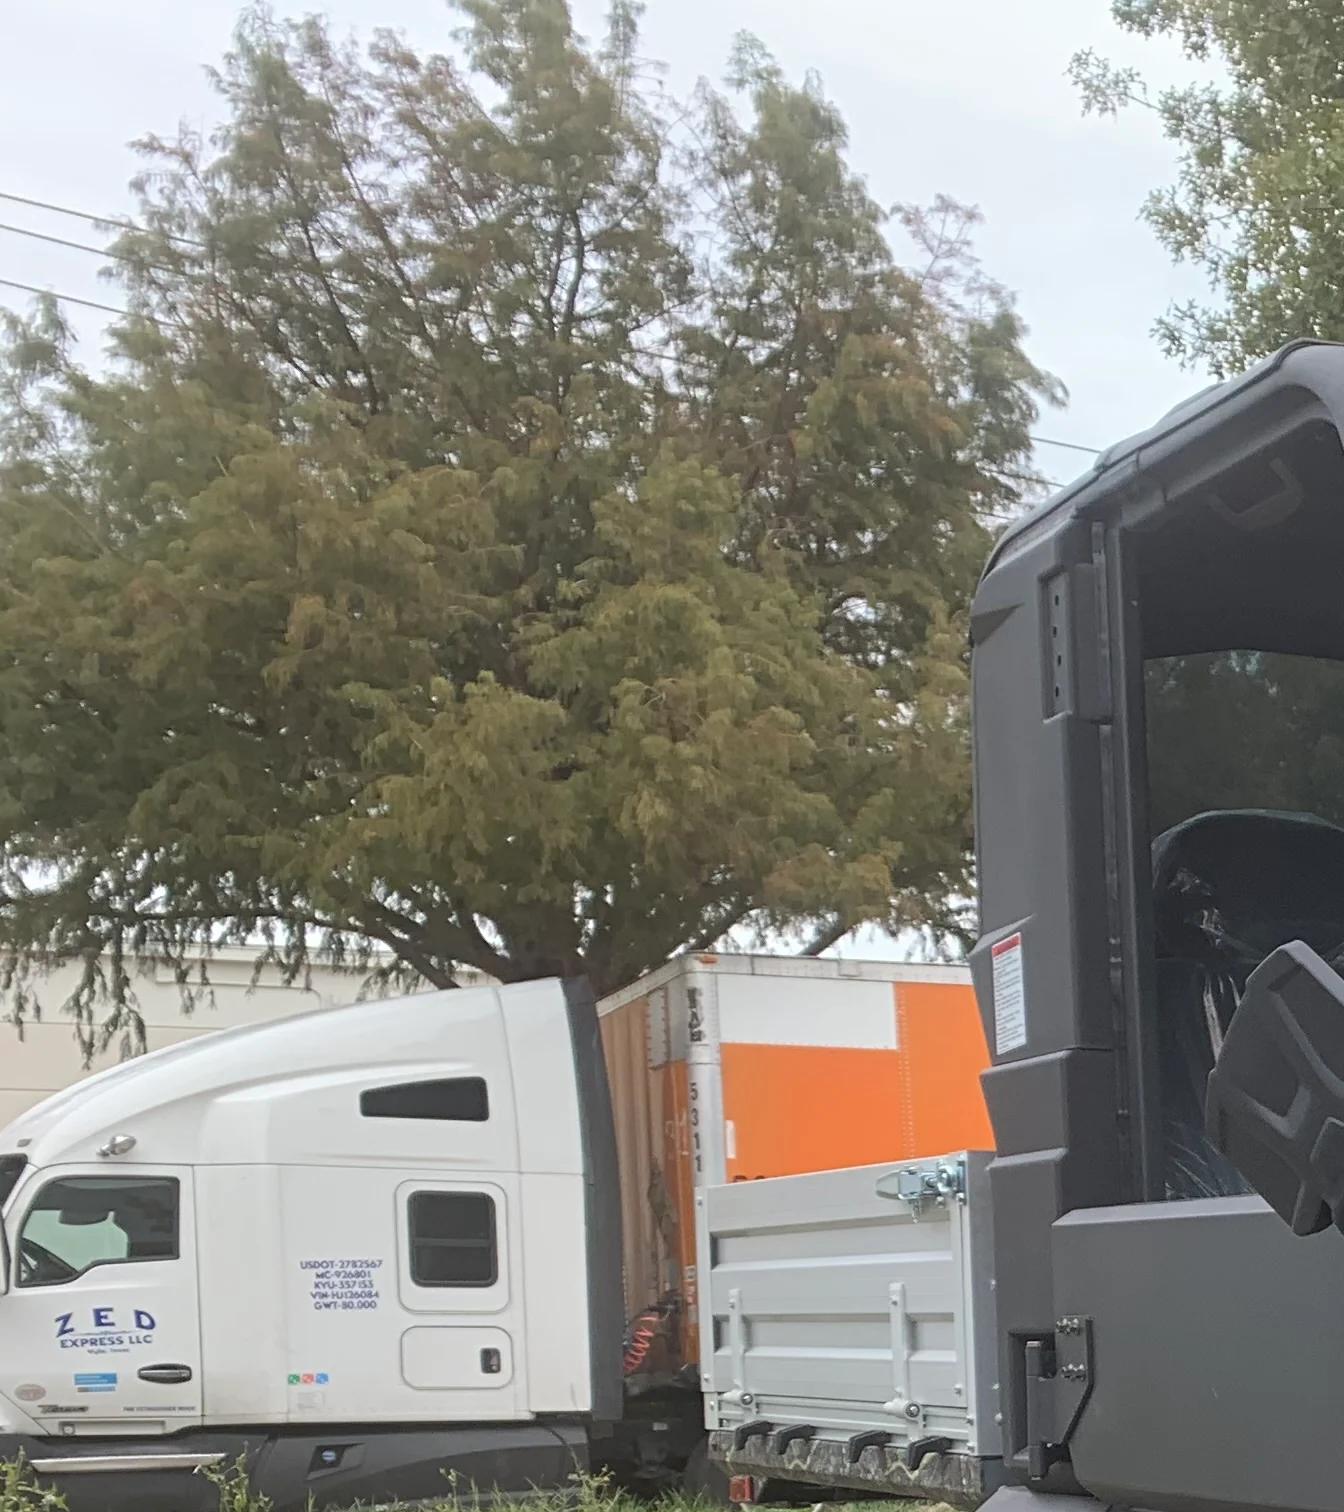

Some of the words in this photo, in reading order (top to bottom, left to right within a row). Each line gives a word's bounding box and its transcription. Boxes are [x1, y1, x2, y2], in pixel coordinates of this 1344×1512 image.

[689, 1082, 702, 1173] 5311
[54, 1307, 157, 1338] ZED
[60, 1336, 124, 1349] EXPRESS
[128, 1334, 153, 1345] LLC
